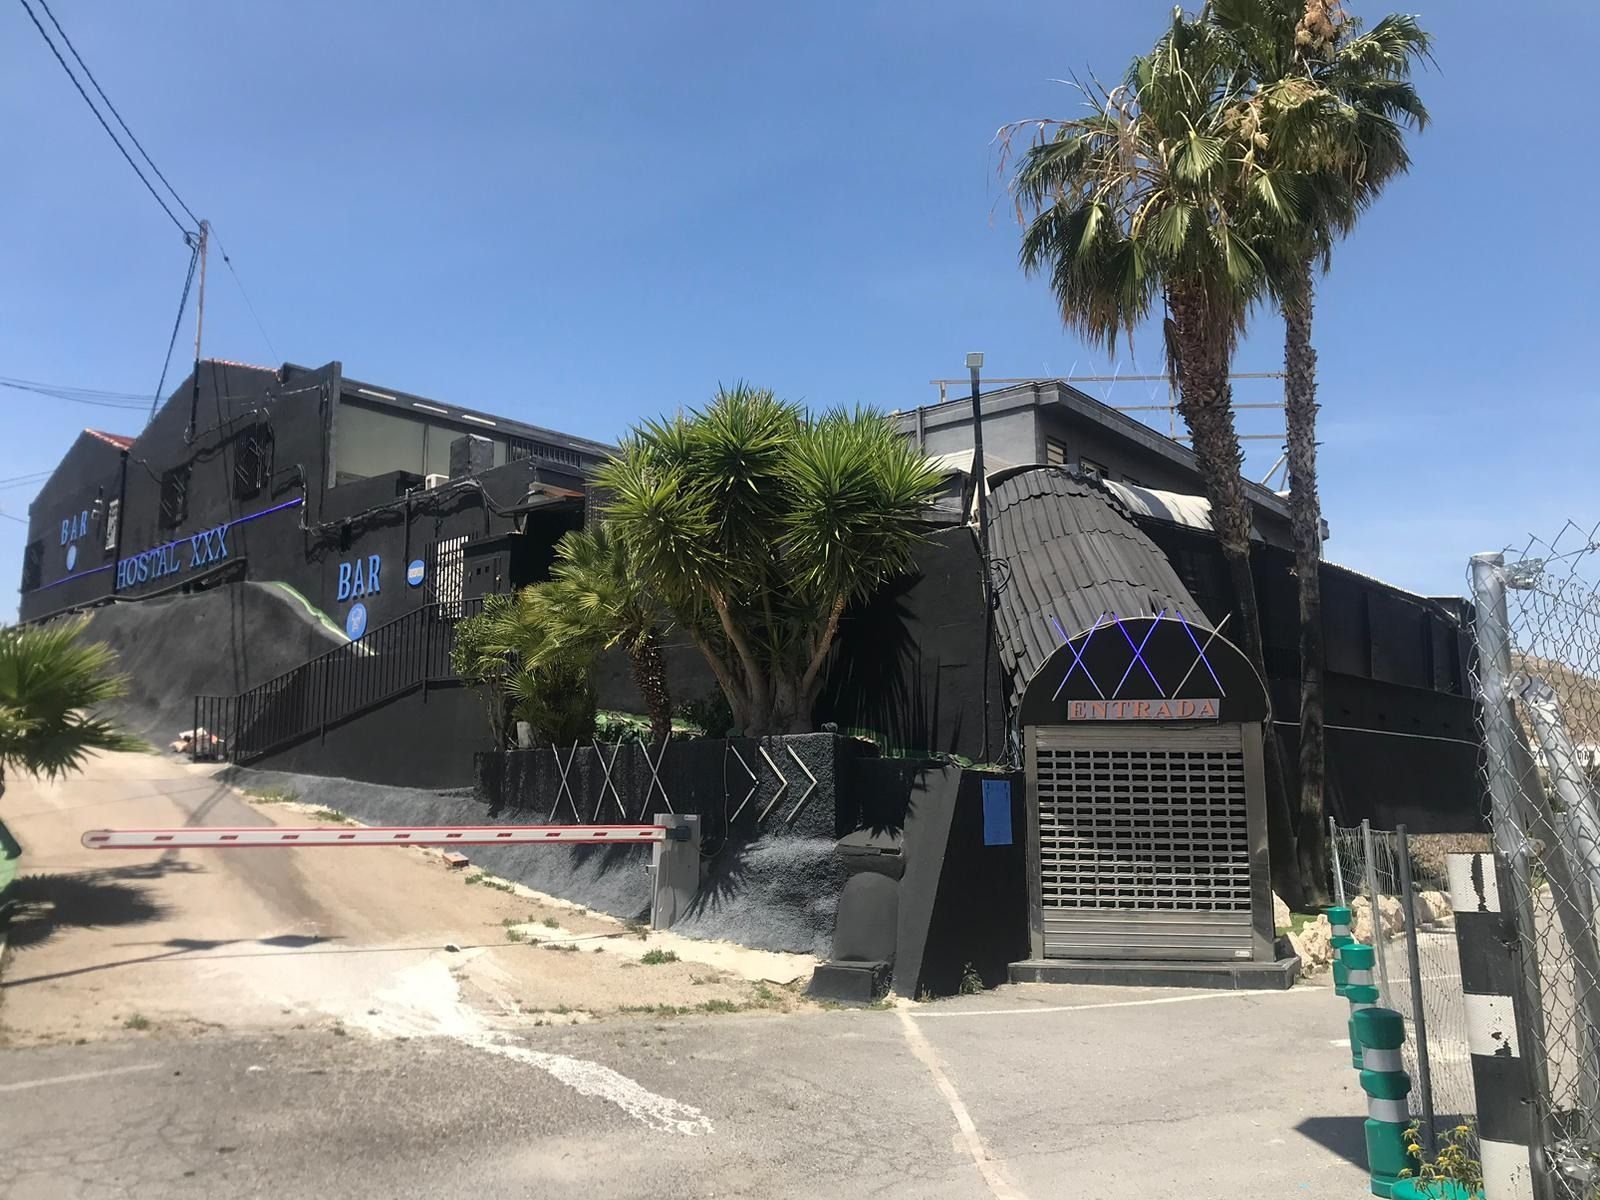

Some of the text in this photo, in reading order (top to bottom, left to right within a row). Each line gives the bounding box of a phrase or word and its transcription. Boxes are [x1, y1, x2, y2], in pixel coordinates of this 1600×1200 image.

[60, 510, 88, 546] BAR
[116, 524, 228, 590] HOSTAL XXX
[337, 554, 381, 601] BAR
[1070, 700, 1218, 720] ENTRADA
